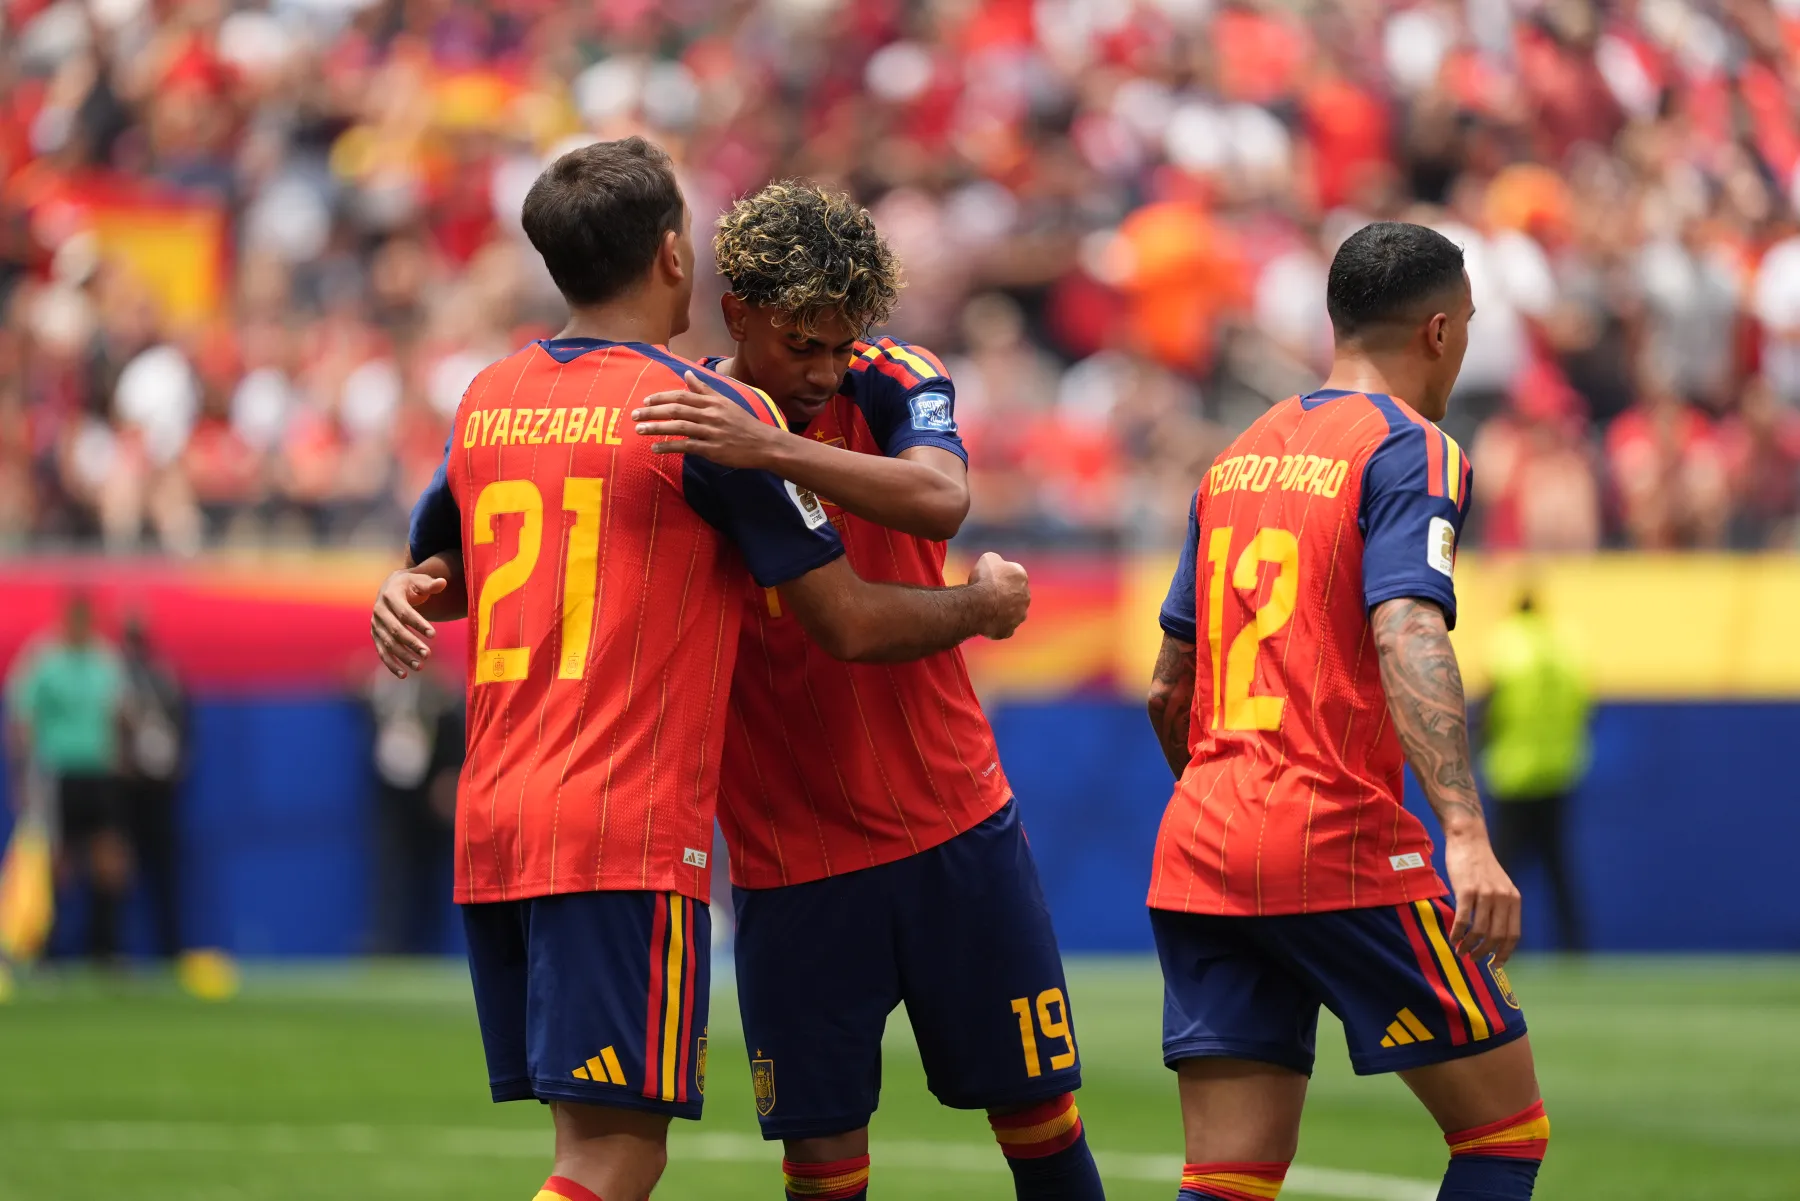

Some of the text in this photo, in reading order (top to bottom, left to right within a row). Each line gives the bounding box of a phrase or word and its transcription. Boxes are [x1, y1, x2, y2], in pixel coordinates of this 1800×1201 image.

[463, 406, 623, 449] OYARZABAL
[1208, 454, 1279, 497] PEDRO
[473, 477, 604, 686] 21
[1207, 526, 1299, 731] 12
[1010, 987, 1075, 1078] 19
